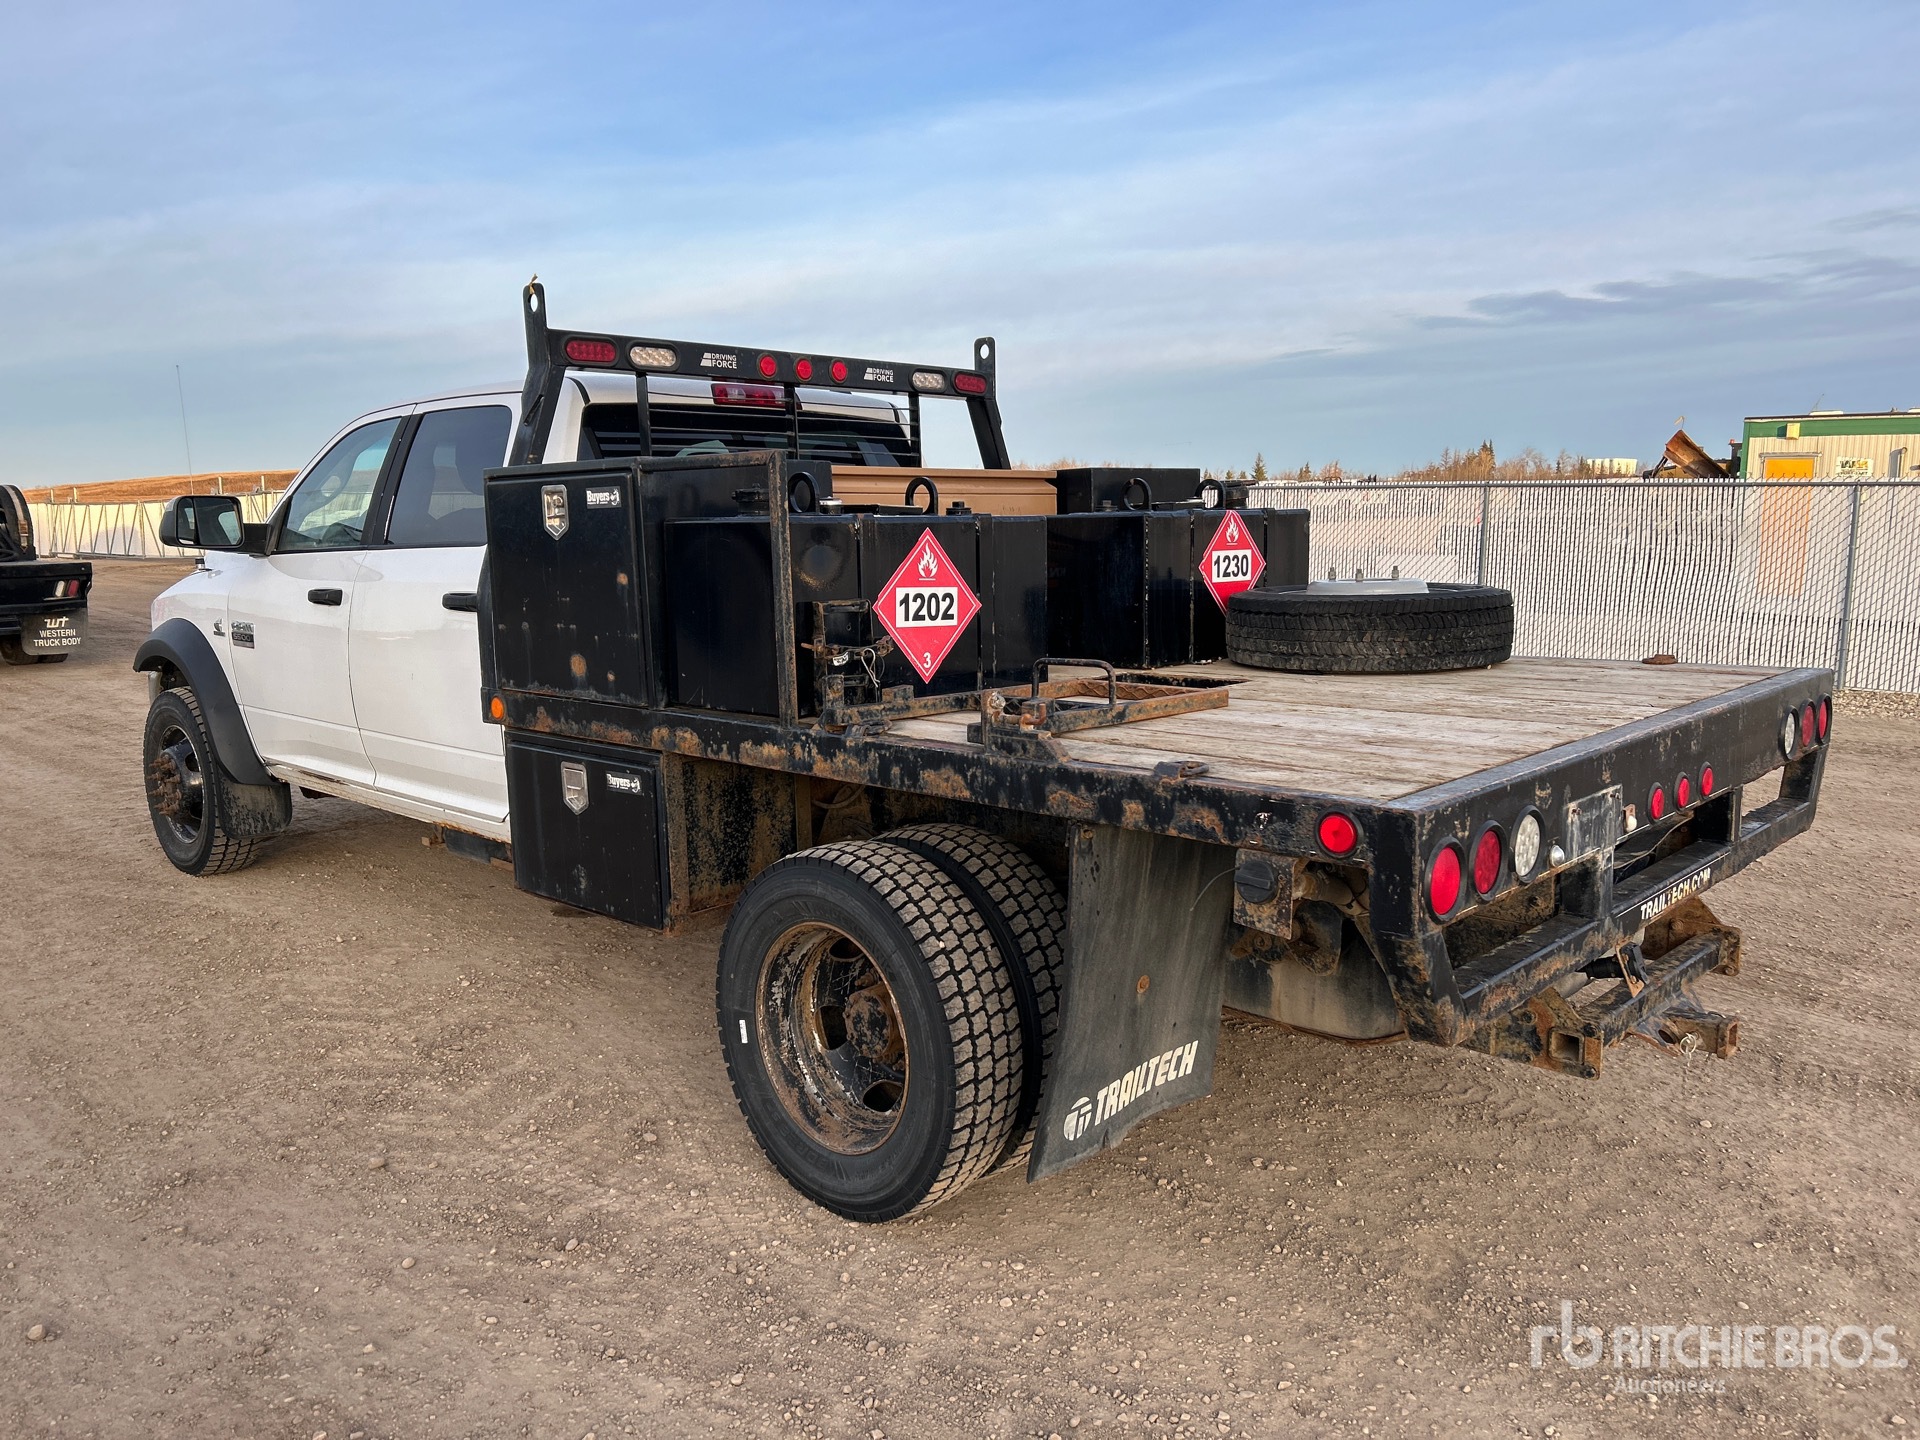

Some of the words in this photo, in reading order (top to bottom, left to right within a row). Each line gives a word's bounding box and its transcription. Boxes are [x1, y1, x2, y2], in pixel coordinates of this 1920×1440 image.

[711, 352, 737, 361] DRIVING
[712, 360, 738, 369] FORCE
[873, 374, 894, 383] FORCE
[586, 490, 610, 504] Buyers
[1213, 554, 1249, 578] 1230
[899, 592, 955, 622] 1202
[39, 628, 76, 638] WESTERN
[33, 638, 60, 647] TRUCK
[61, 637, 81, 646] BODY
[923, 652, 932, 668] 3
[606, 773, 630, 788] Buyers
[1095, 1040, 1199, 1126] TRAILTECH
